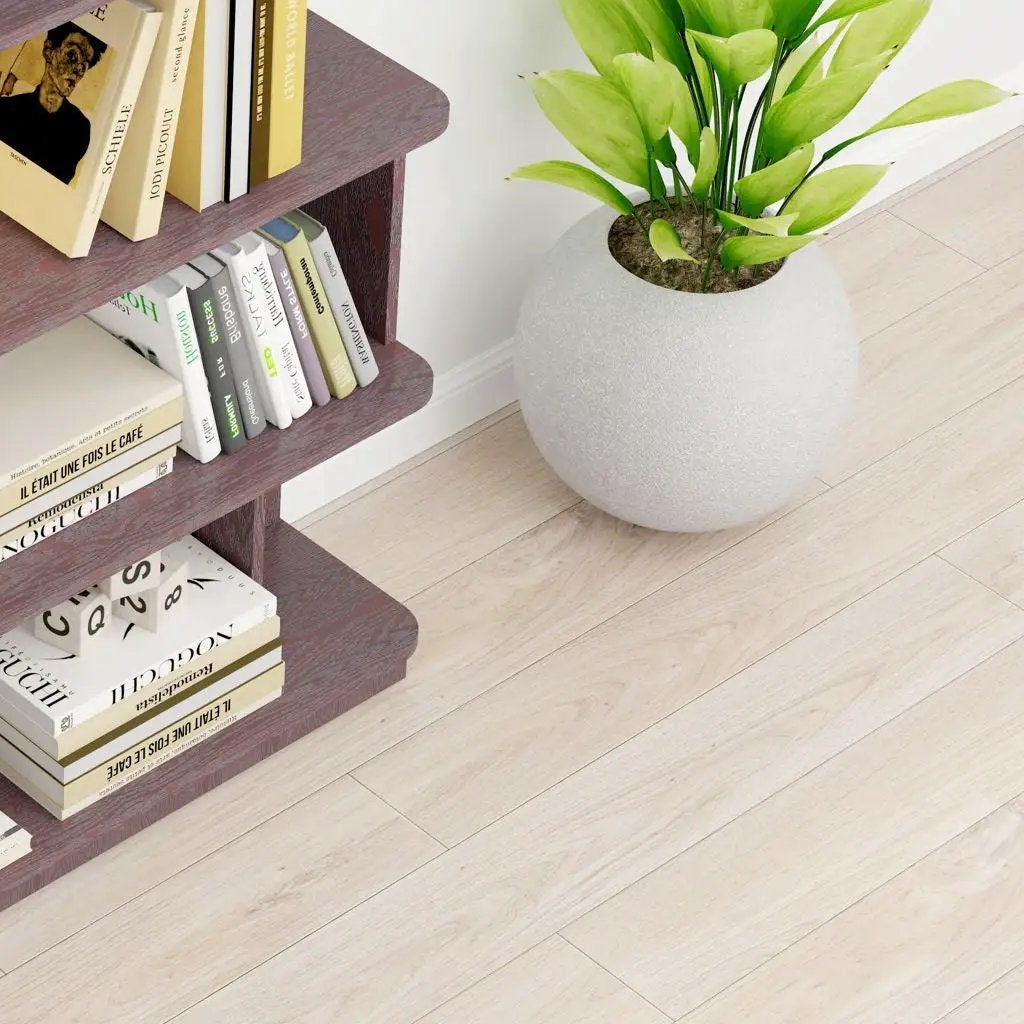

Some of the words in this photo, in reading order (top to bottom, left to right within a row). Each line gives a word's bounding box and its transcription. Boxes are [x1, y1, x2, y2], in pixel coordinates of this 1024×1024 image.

[172, 45, 184, 83] second
[178, 7, 190, 43] glance
[101, 103, 133, 175] SCHIELE
[156, 108, 175, 168] PICOULT
[150, 170, 164, 200] JODI
[20, 485, 30, 500] IL
[31, 470, 59, 495] ÉTAIT
[60, 458, 80, 479] UNE
[82, 446, 104, 468] FOIS
[105, 439, 117, 456] LE
[119, 423, 144, 448] CAFÉ
[1, 486, 121, 561] NOGUCHI
[88, 604, 105, 636] Q
[111, 623, 234, 705] NOGUCHI
[136, 662, 214, 711] Remodelista
[193, 705, 220, 730] ÉTAIT
[223, 698, 232, 713] IL
[148, 733, 170, 756] FOIS
[171, 721, 192, 744] UNE
[107, 755, 132, 782] CAFÉ
[134, 748, 146, 765] LE
